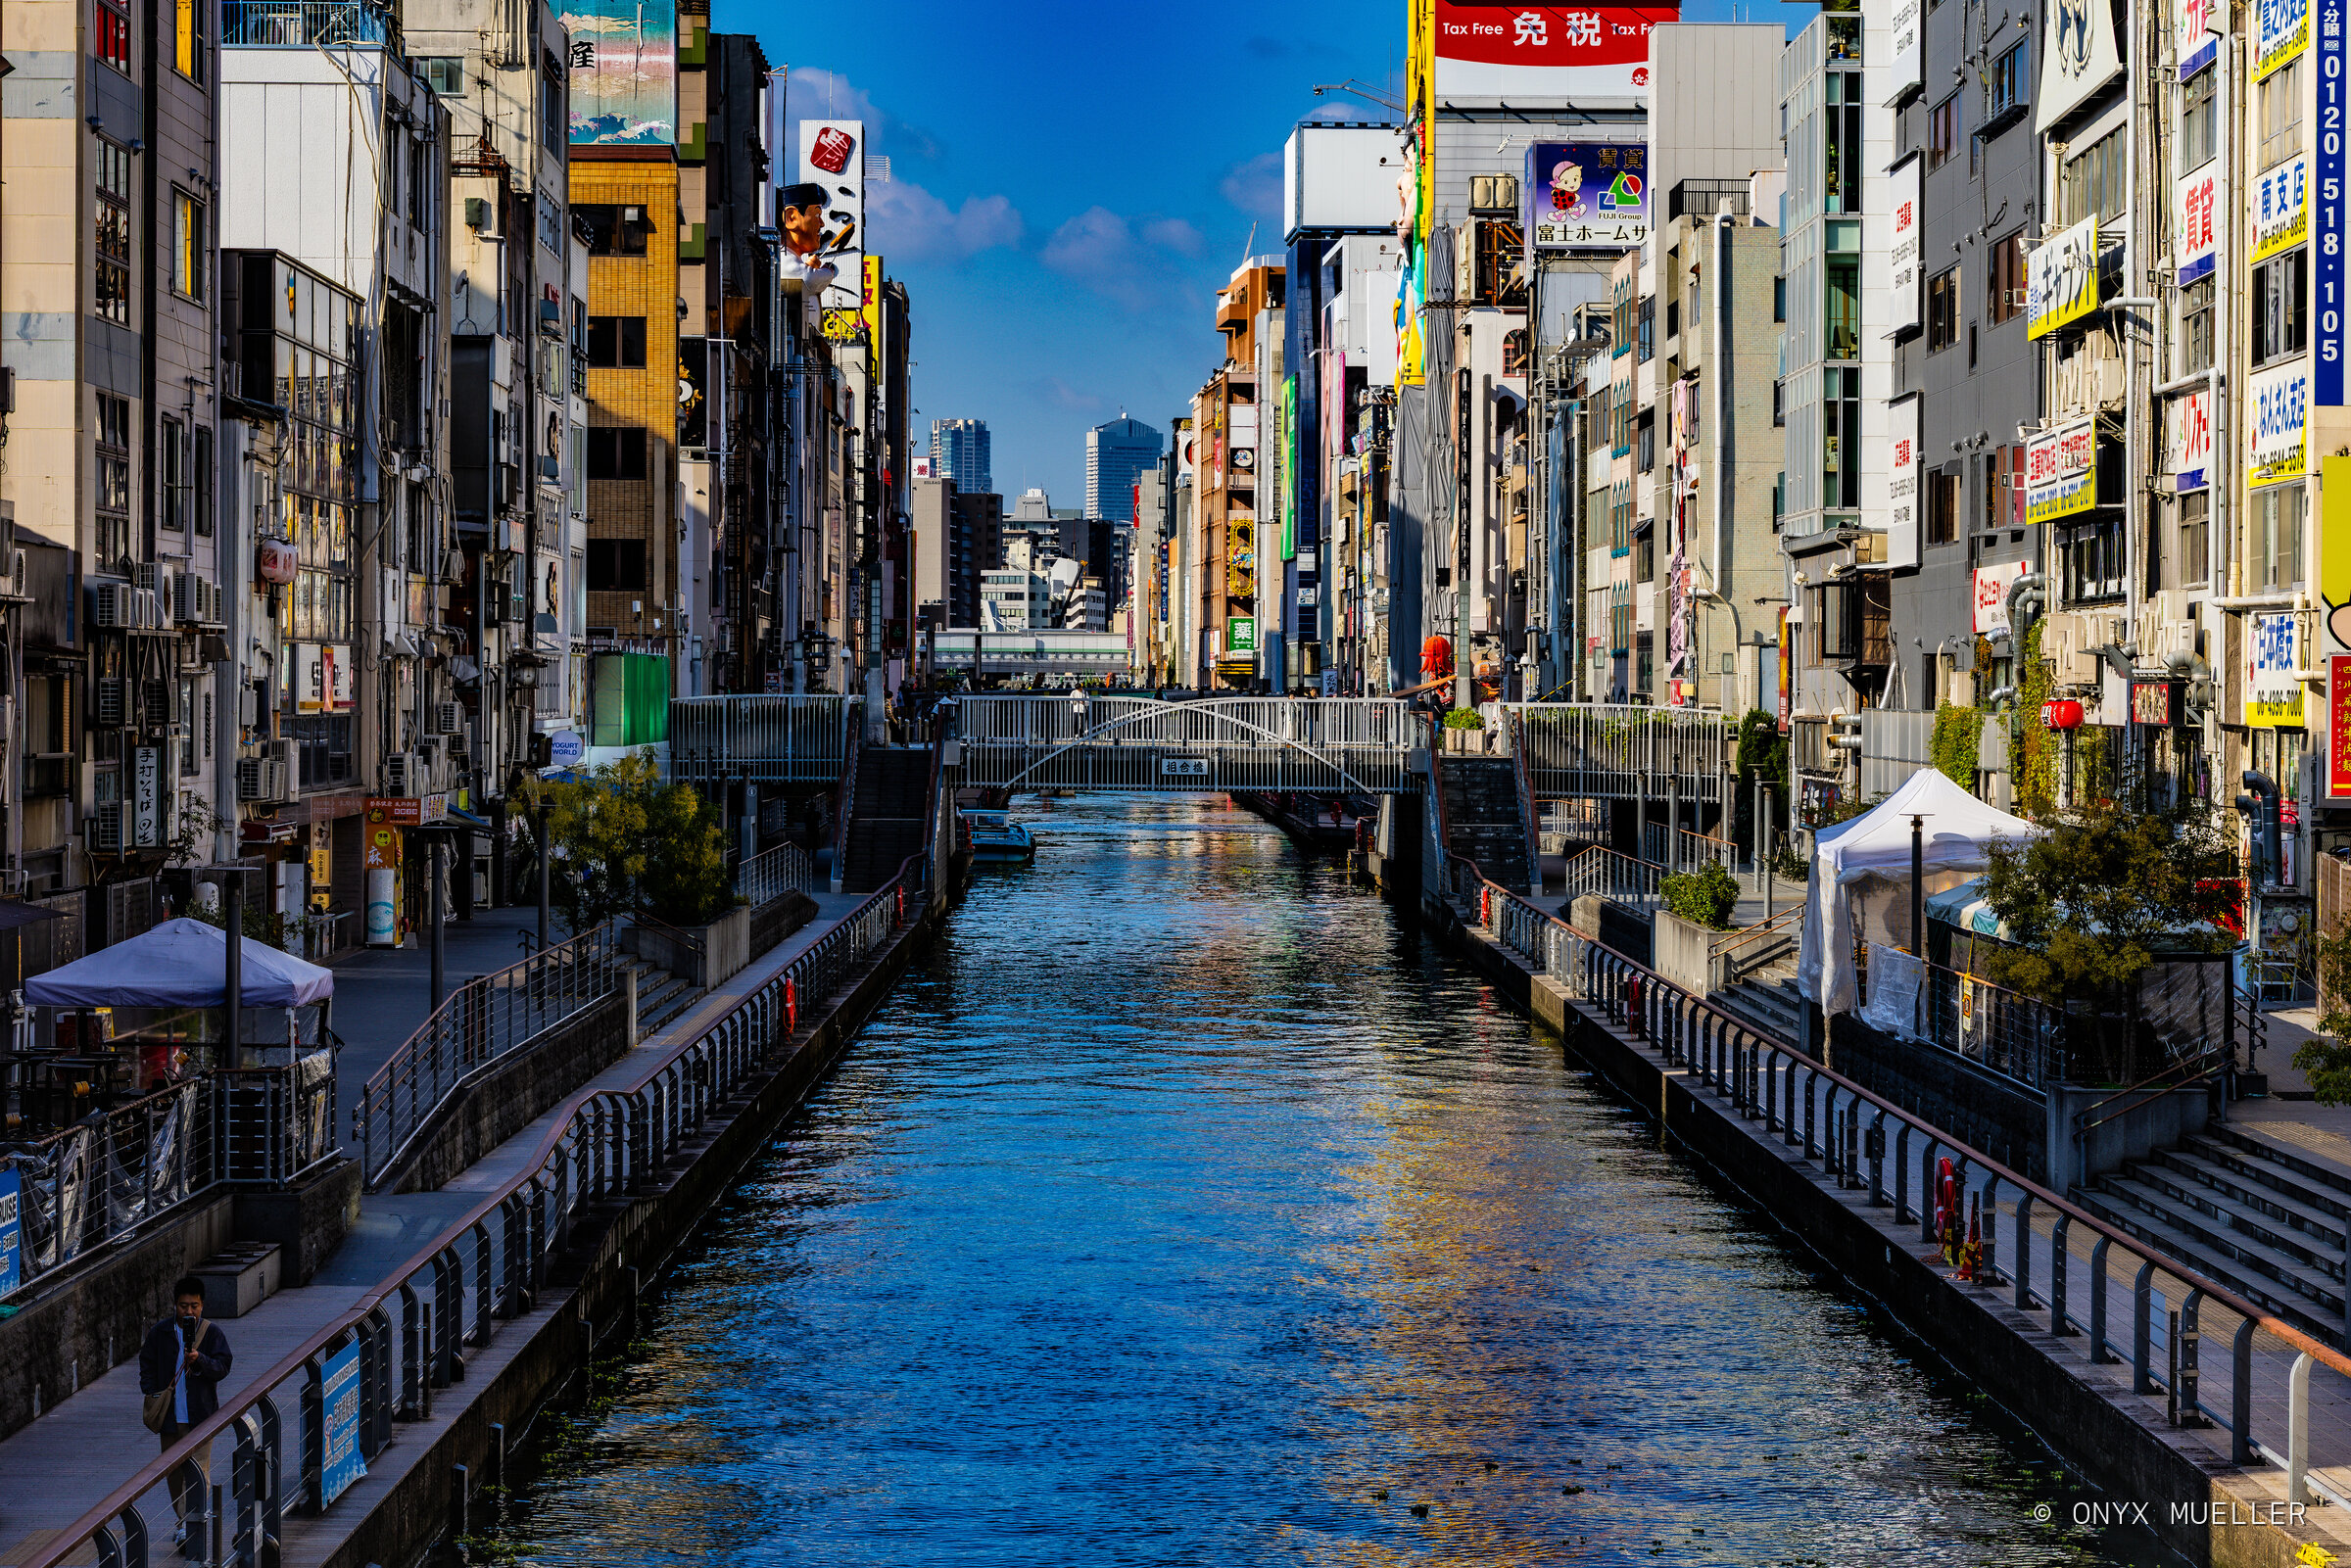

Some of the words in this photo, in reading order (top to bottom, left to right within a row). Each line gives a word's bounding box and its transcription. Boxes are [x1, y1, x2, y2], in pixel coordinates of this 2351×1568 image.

[1443, 23, 1468, 34] Tax
[1472, 23, 1504, 35] Free
[1512, 12, 1602, 46] 免税
[1612, 23, 1636, 35] Tax
[2262, 22, 2308, 69] 06-6765-1306
[569, 40, 596, 70] 産
[1598, 149, 1644, 168] 賃貸
[2261, 161, 2306, 223] 南支店
[1538, 224, 1647, 242] 富士ホームサ
[2184, 177, 2214, 257] 賃貸
[2260, 211, 2307, 247] 06-6241-8839
[2259, 374, 2306, 439] なんさん支店
[2183, 391, 2211, 466] リフォー
[1234, 622, 1252, 640] 薬
[2258, 614, 2294, 671] 日本橋支
[2257, 689, 2303, 717] 06-4396-7000
[552, 741, 579, 750] YOGURT
[1166, 761, 1204, 773] 相合橋
